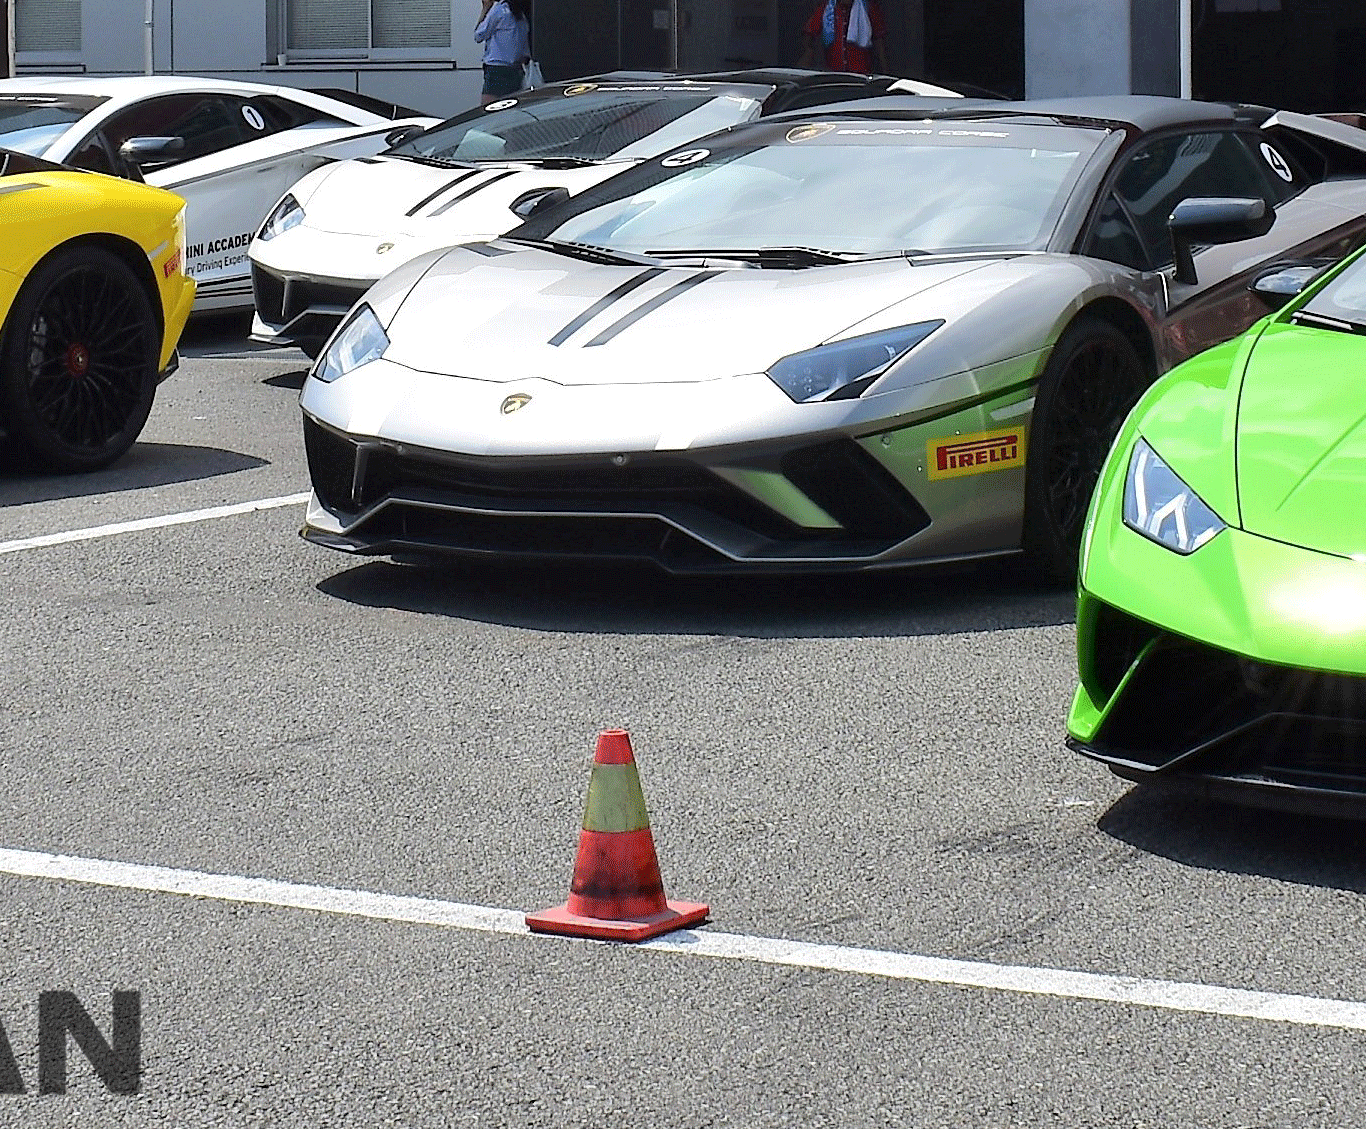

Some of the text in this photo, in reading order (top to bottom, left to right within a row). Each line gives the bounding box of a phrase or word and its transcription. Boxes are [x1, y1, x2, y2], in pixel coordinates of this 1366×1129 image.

[246, 108, 261, 128] 1
[1267, 146, 1290, 178] 4
[936, 434, 1018, 471] PIRELLI
